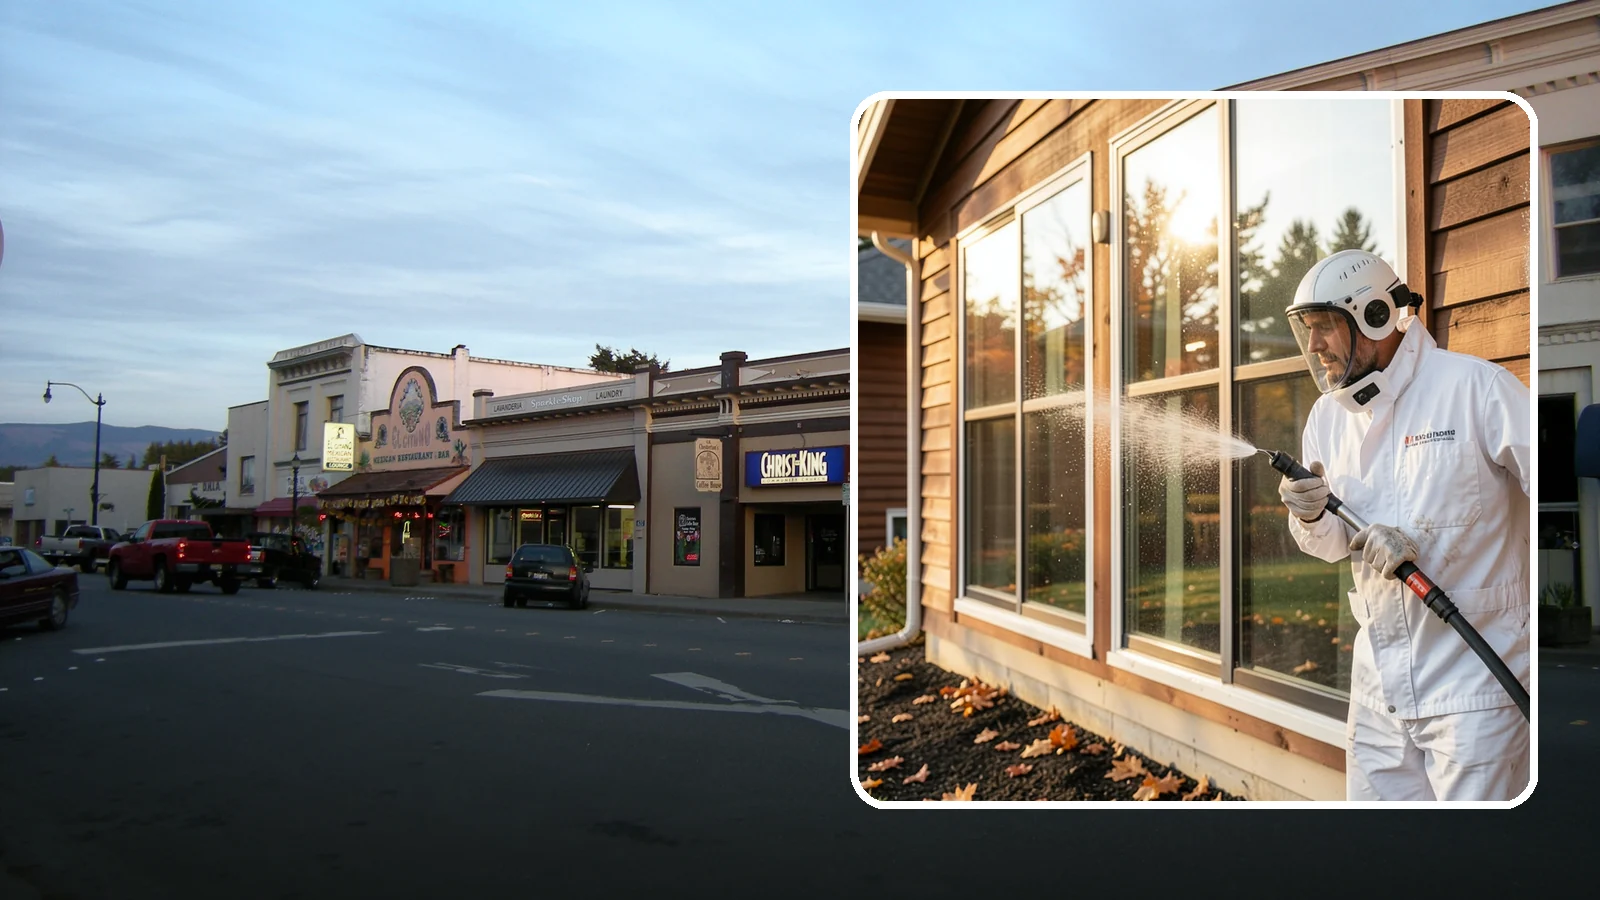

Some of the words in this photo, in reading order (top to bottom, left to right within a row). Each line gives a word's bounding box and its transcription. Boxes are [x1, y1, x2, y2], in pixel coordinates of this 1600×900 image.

[530, 396, 561, 409] Sparkle
[562, 394, 583, 405] Shop
[595, 389, 623, 400] LAUNDRY
[493, 402, 522, 412] LAVANDERIA
[373, 454, 396, 464] MEXICAN
[397, 451, 434, 462] RESTAURANT
[437, 450, 450, 459] BAR
[760, 451, 797, 478] CHRIST
[799, 450, 827, 476] KING
